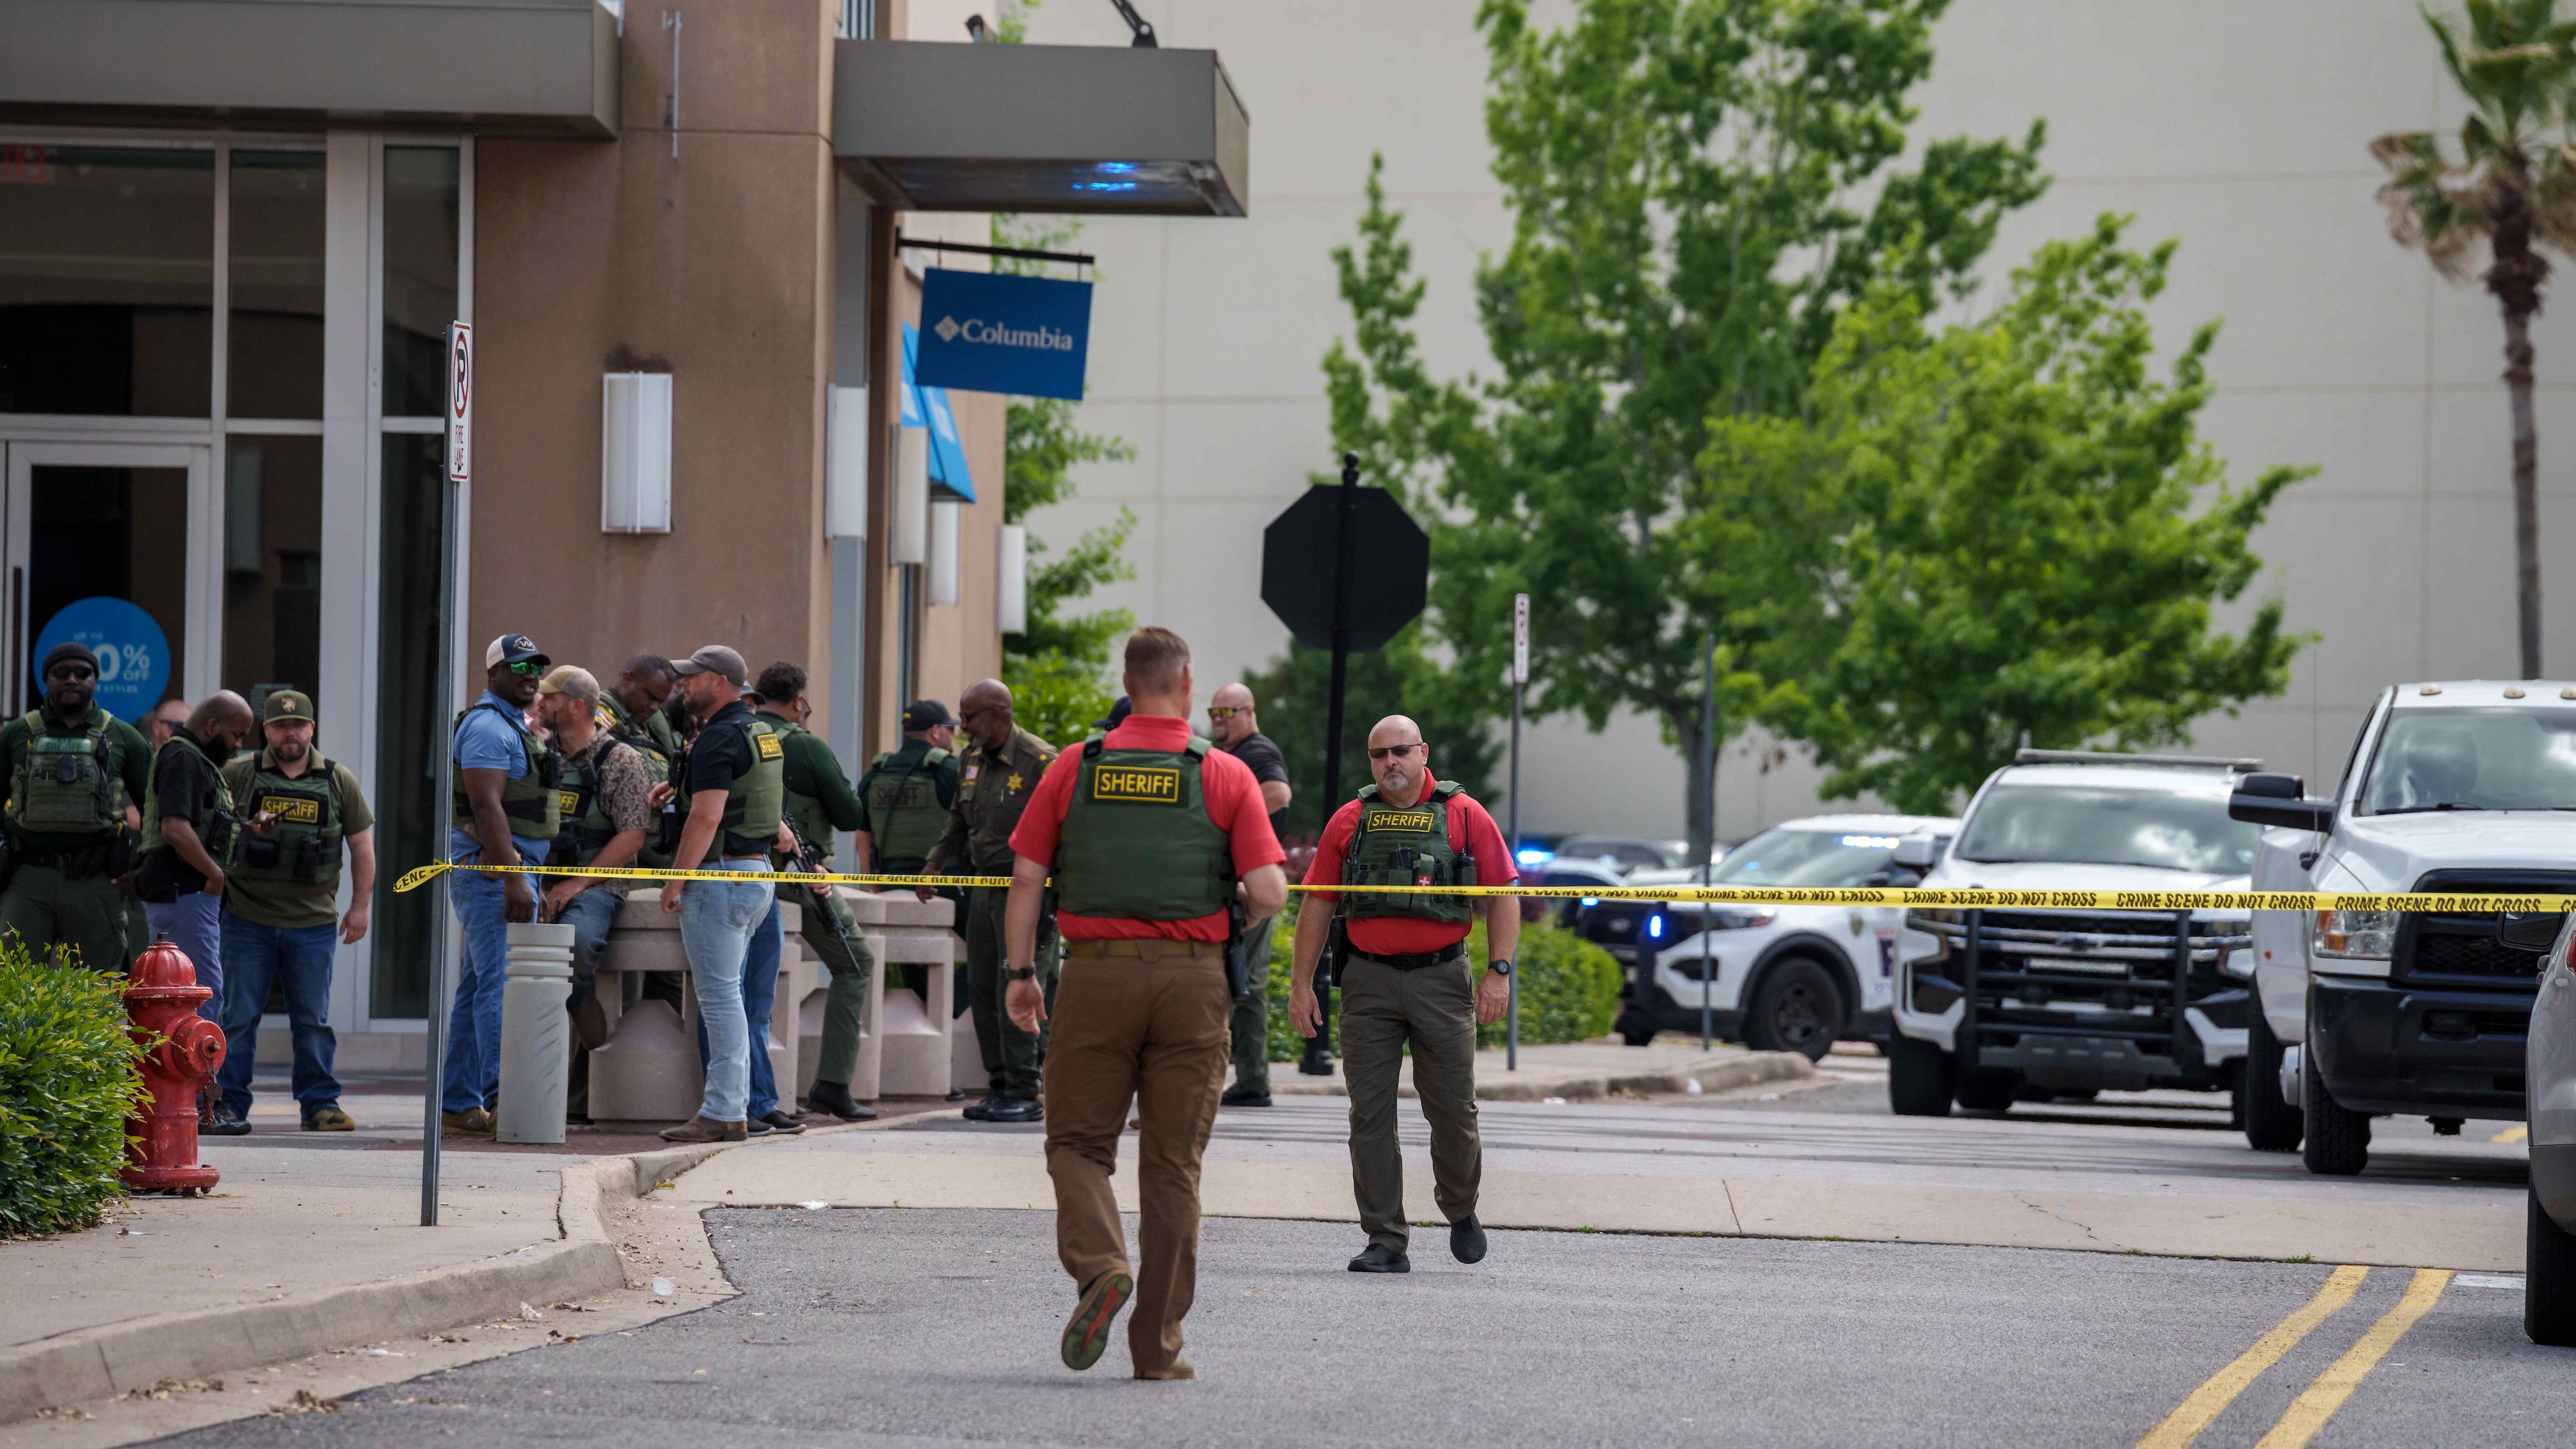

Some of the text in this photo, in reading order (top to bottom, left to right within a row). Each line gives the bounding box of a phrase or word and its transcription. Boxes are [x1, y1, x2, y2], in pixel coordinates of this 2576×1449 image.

[961, 319, 1073, 351] Columbia
[123, 669, 150, 682] OFF
[1100, 773, 1174, 794] SHERIFF
[266, 800, 315, 817] SHERIFF
[1372, 814, 1430, 827] SHERIFF
[1902, 891, 2097, 906] CRIME SCENE DO NOT CROSS
[2116, 893, 2316, 910] CRIME SCENE DO NOT CROSS
[2334, 896, 2541, 912] CRIME SCENE DO NOT CROSS
